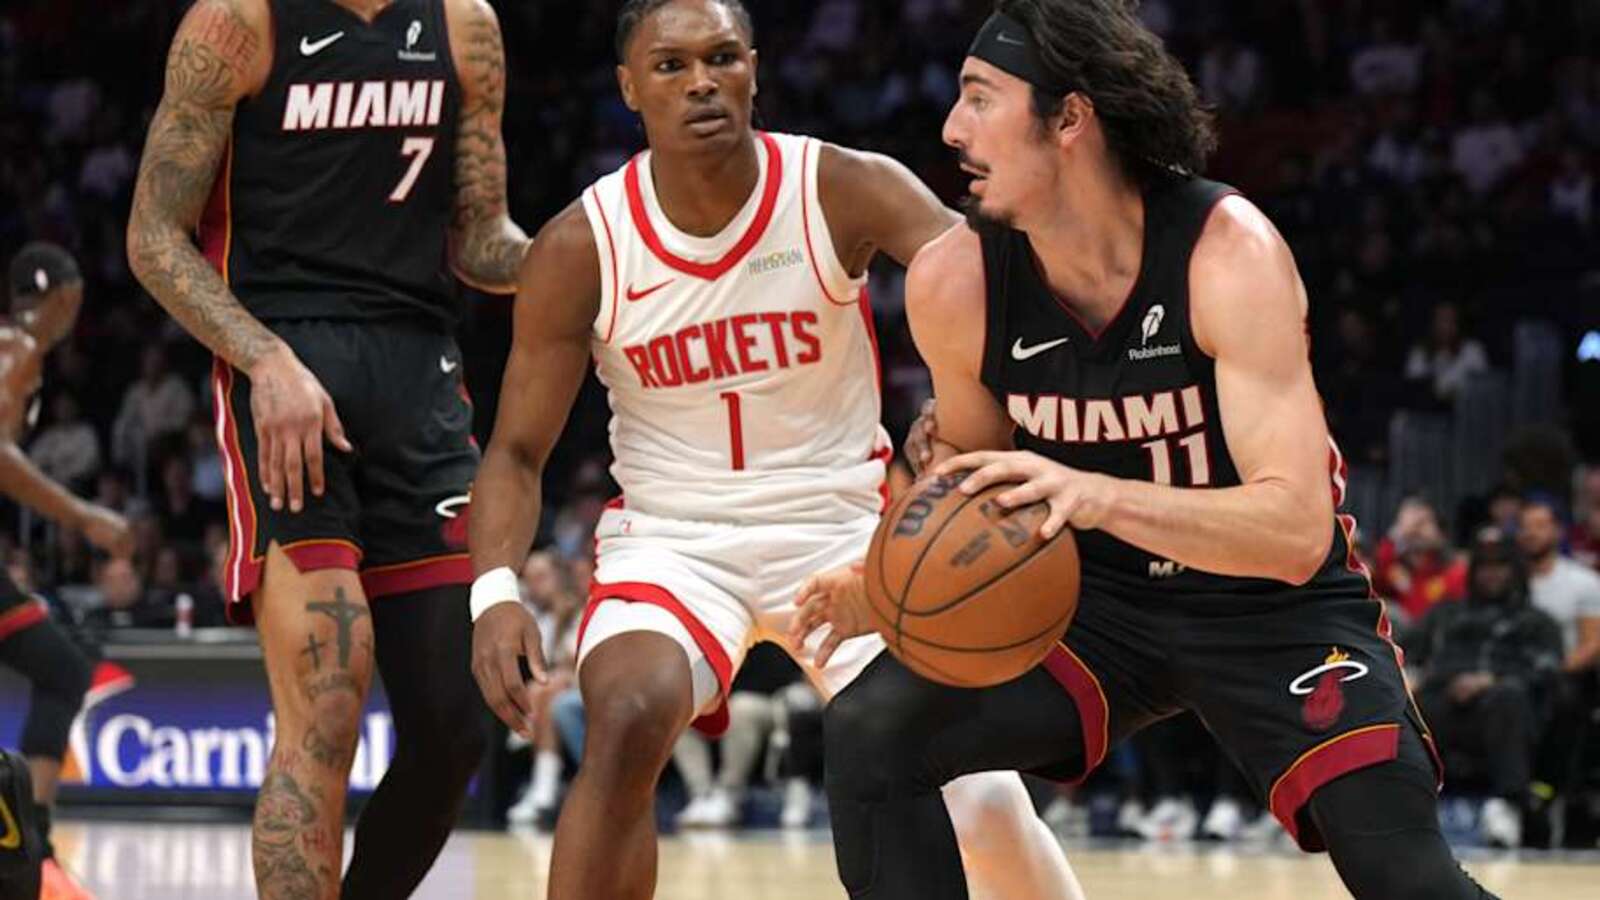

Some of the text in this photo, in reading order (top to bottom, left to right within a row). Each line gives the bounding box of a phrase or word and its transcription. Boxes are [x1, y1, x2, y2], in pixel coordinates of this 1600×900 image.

[282, 79, 446, 133] MIAMI
[386, 136, 436, 202] 7
[622, 310, 822, 389] ROCKETS
[719, 391, 745, 471] 1
[1007, 384, 1205, 443] MIAMI
[1140, 431, 1210, 486] 11
[96, 712, 394, 789] Carnl
